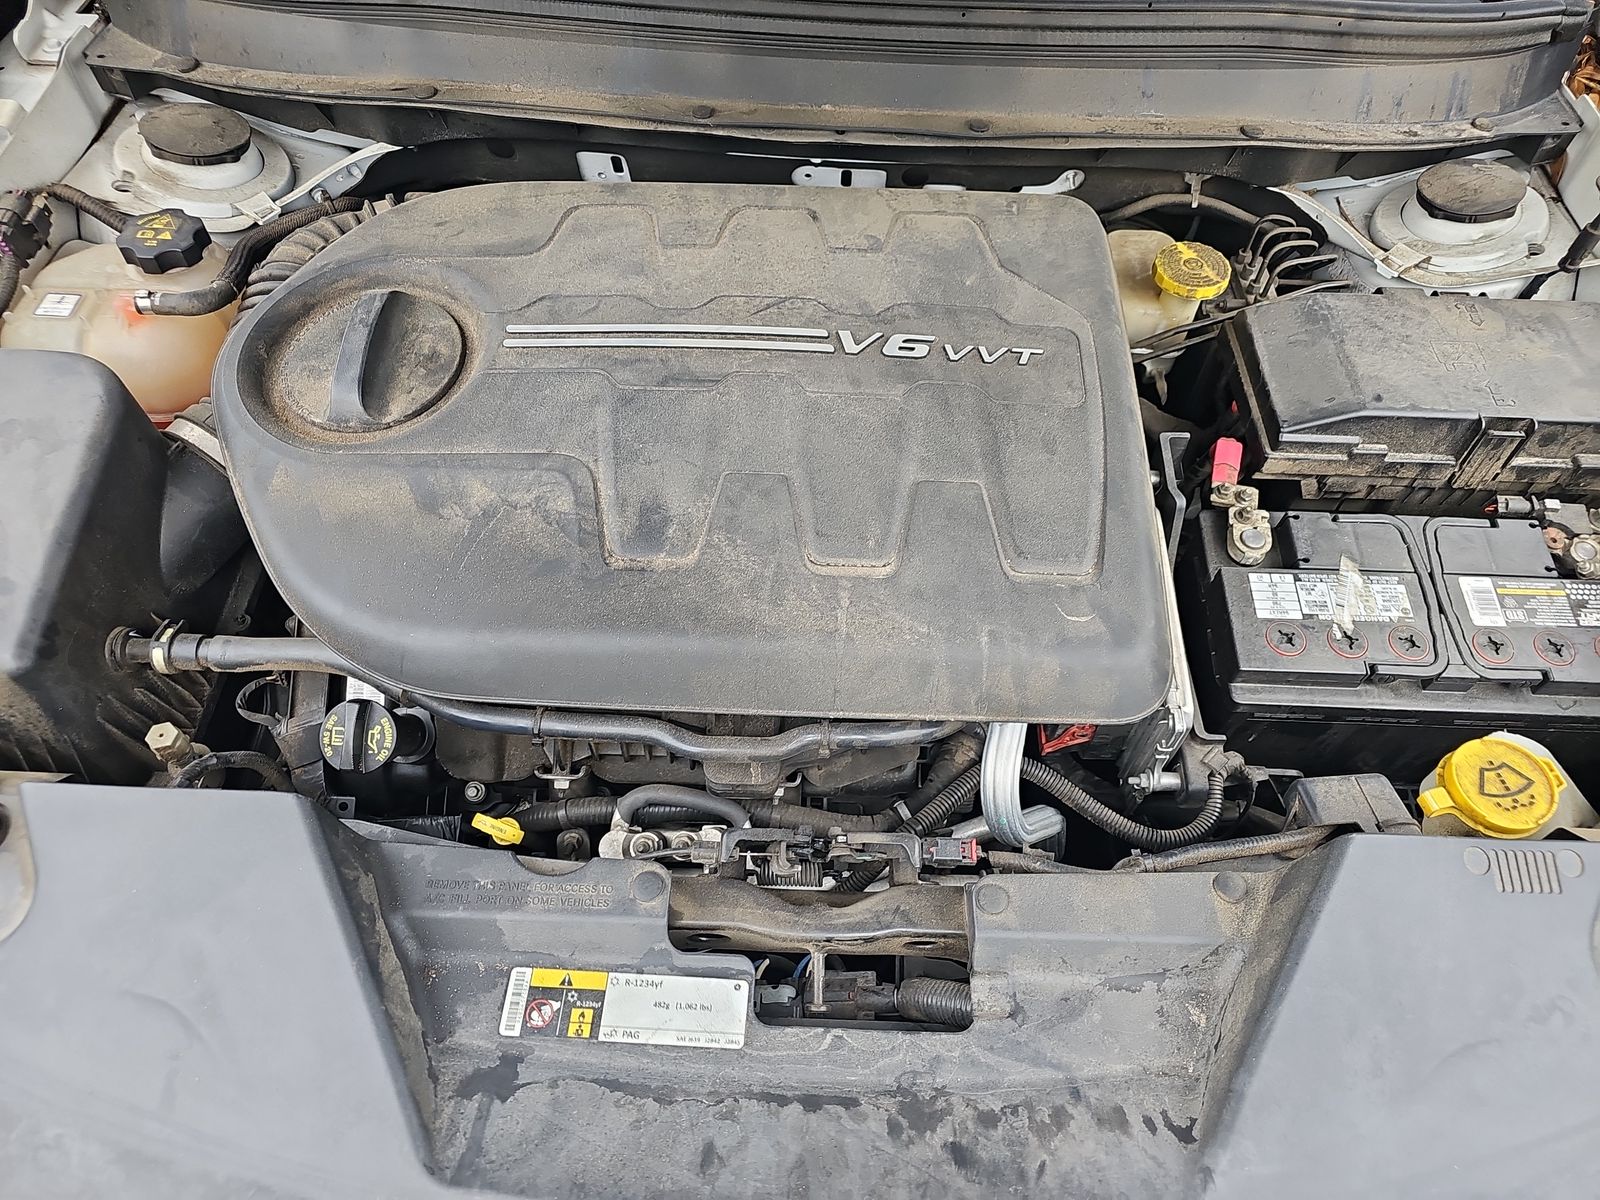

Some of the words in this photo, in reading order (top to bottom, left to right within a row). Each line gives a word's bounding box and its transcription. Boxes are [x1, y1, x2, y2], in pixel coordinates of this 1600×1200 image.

[838, 330, 936, 358] V6
[944, 343, 1045, 366] VVT
[325, 714, 338, 730] SAE
[380, 717, 393, 749] ENGINE
[322, 731, 333, 757] 5W-20
[375, 749, 389, 762] OIL
[424, 879, 470, 890] REMOVE
[474, 879, 496, 890] THIS
[499, 881, 531, 892] PANEL
[534, 882, 555, 892] FOR
[557, 882, 598, 894] ACCESS
[600, 884, 614, 894] TO
[426, 892, 446, 904] A/C
[450, 893, 471, 904] FILL
[475, 894, 502, 905] PORT
[507, 896, 523, 906] ON
[525, 896, 556, 907] SOME
[560, 897, 610, 908] VEHICLES
[624, 978, 663, 990] R-1234yf
[653, 1000, 670, 1010] 482g
[699, 1003, 713, 1013] lbs)
[621, 1030, 640, 1040] PAG
